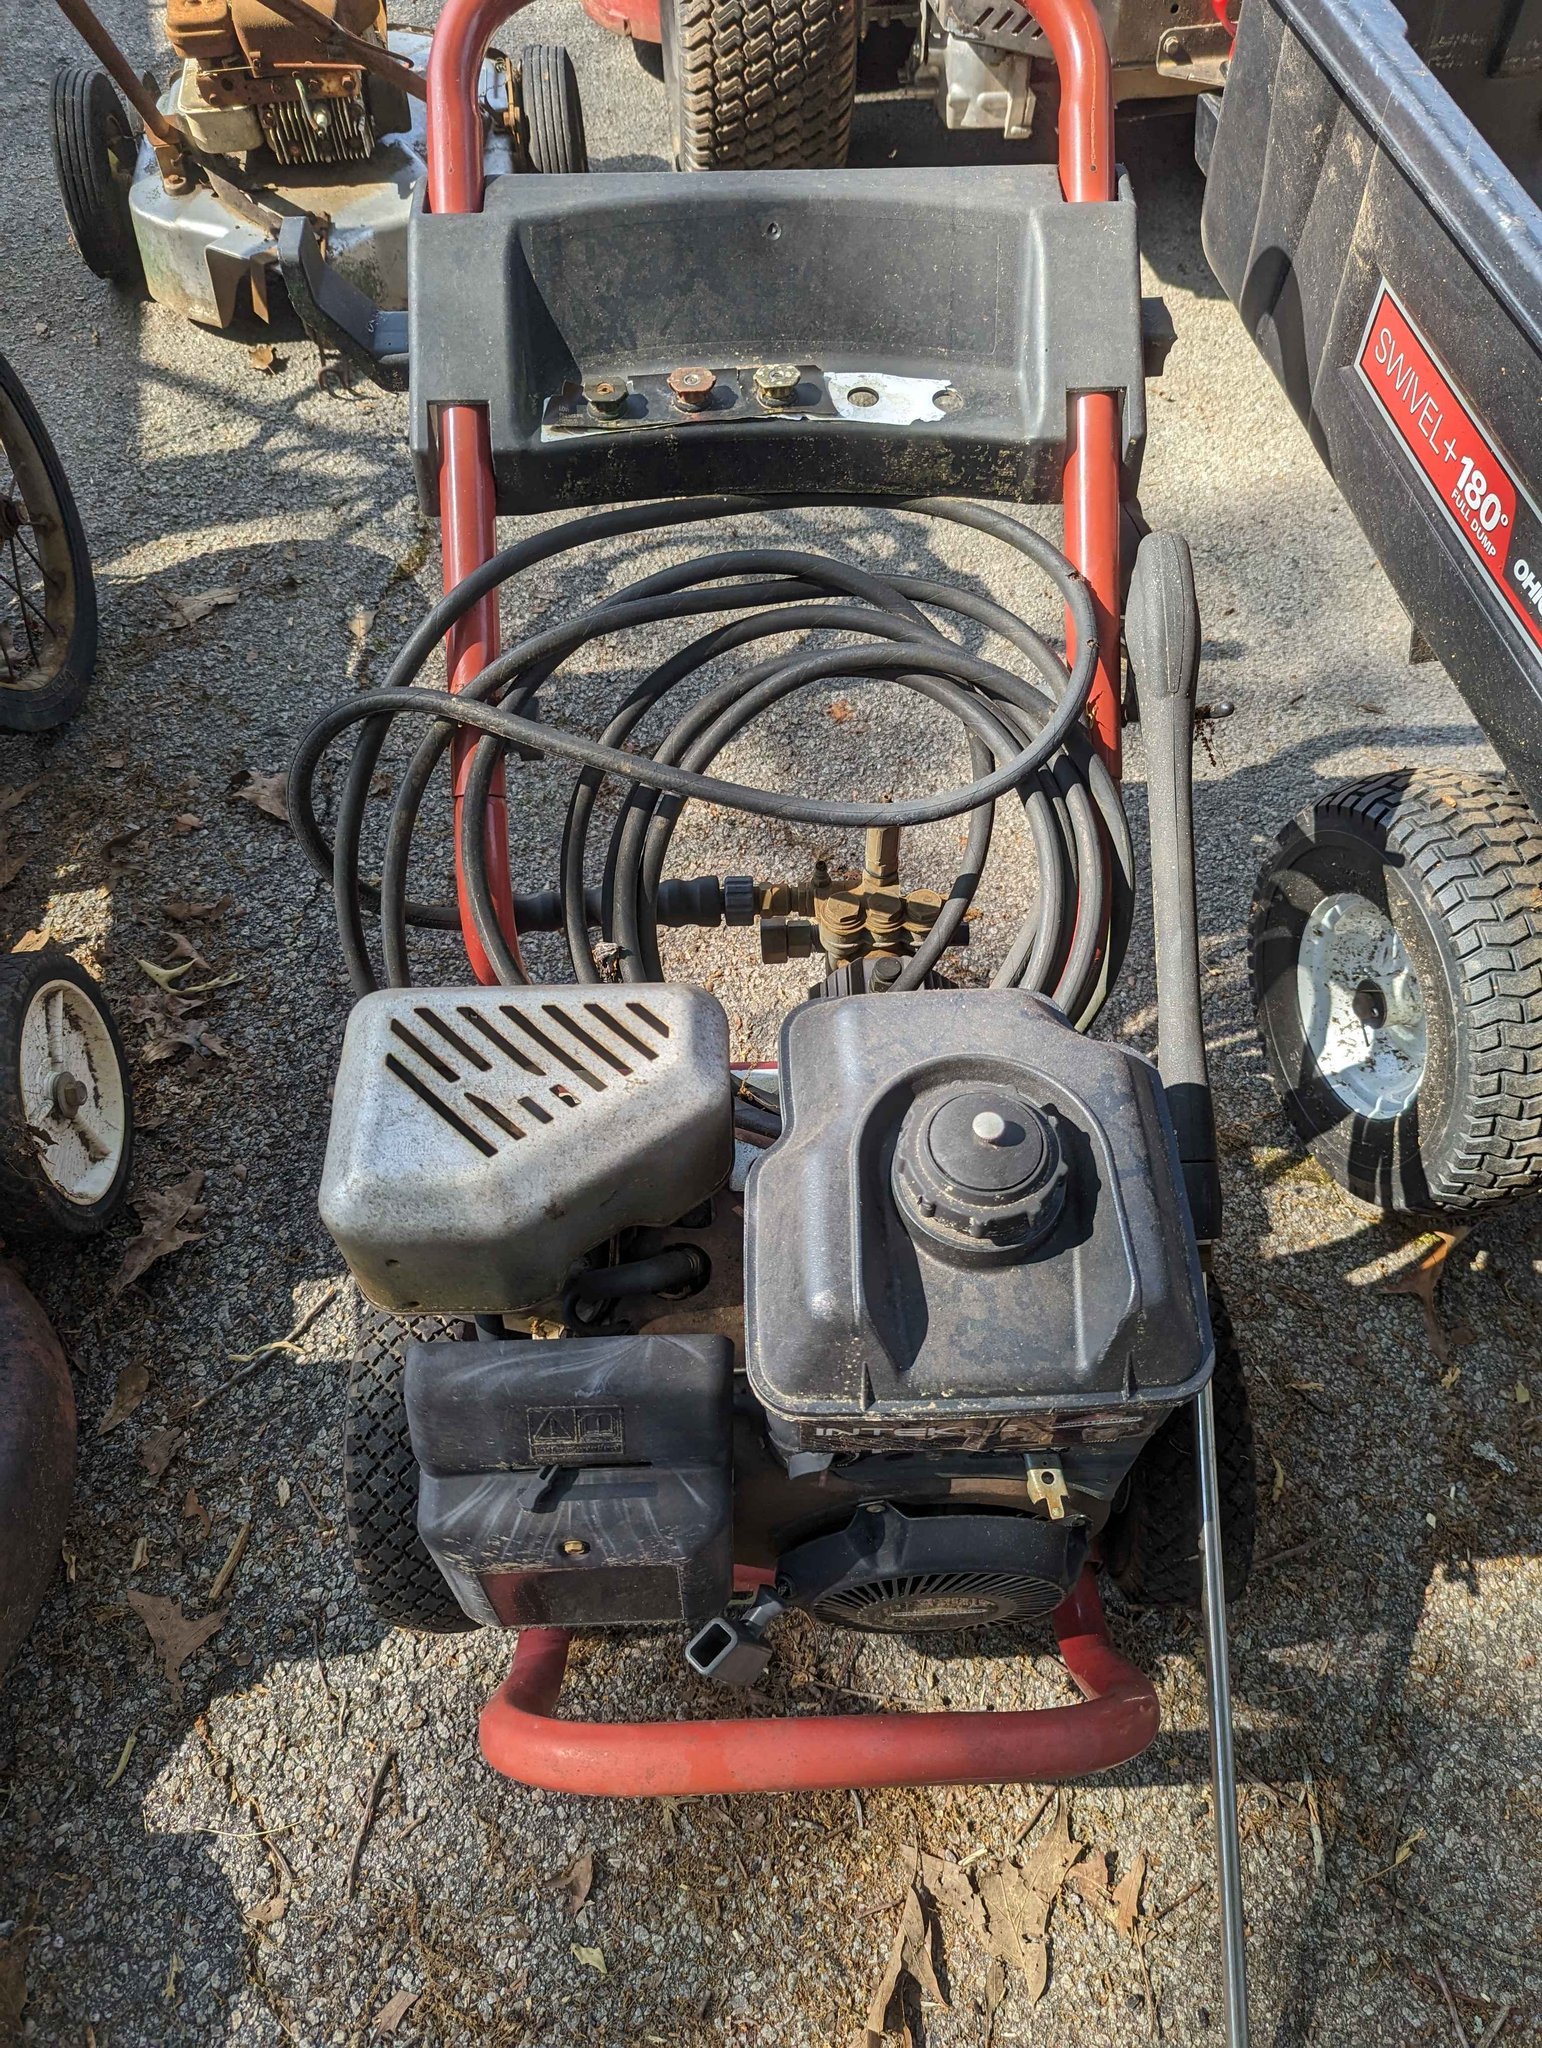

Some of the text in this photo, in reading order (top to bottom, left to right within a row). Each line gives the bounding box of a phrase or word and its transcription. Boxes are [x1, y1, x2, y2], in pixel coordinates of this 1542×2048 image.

[1451, 488, 1497, 557] FULL DUMP
[1513, 558, 1542, 616] OHI
